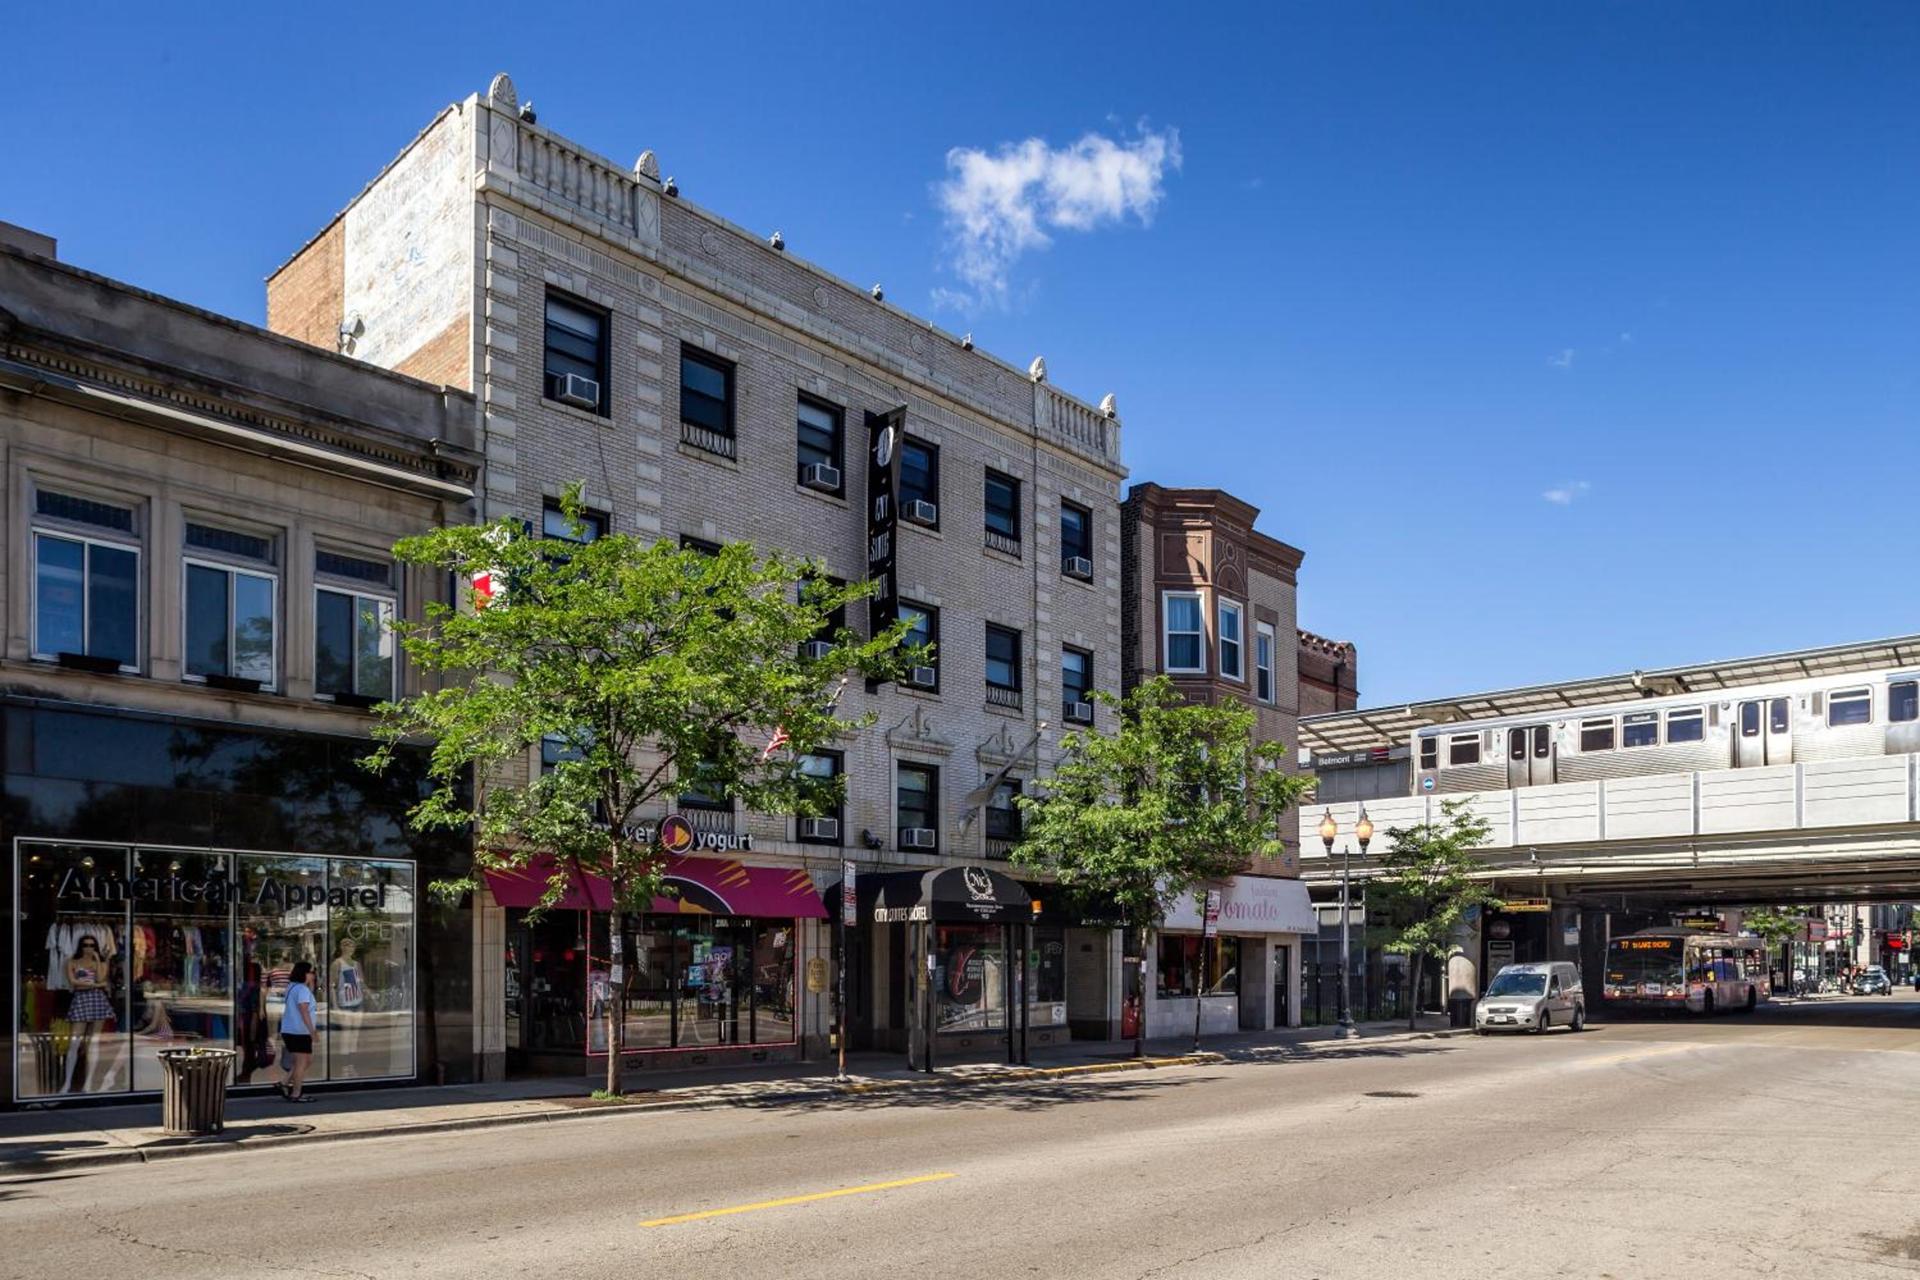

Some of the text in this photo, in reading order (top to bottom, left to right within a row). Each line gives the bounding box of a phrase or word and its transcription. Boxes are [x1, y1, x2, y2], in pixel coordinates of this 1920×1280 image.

[1318, 755, 1350, 766] Belmont
[697, 832, 754, 851] yogurt
[57, 867, 385, 911] American Apparel
